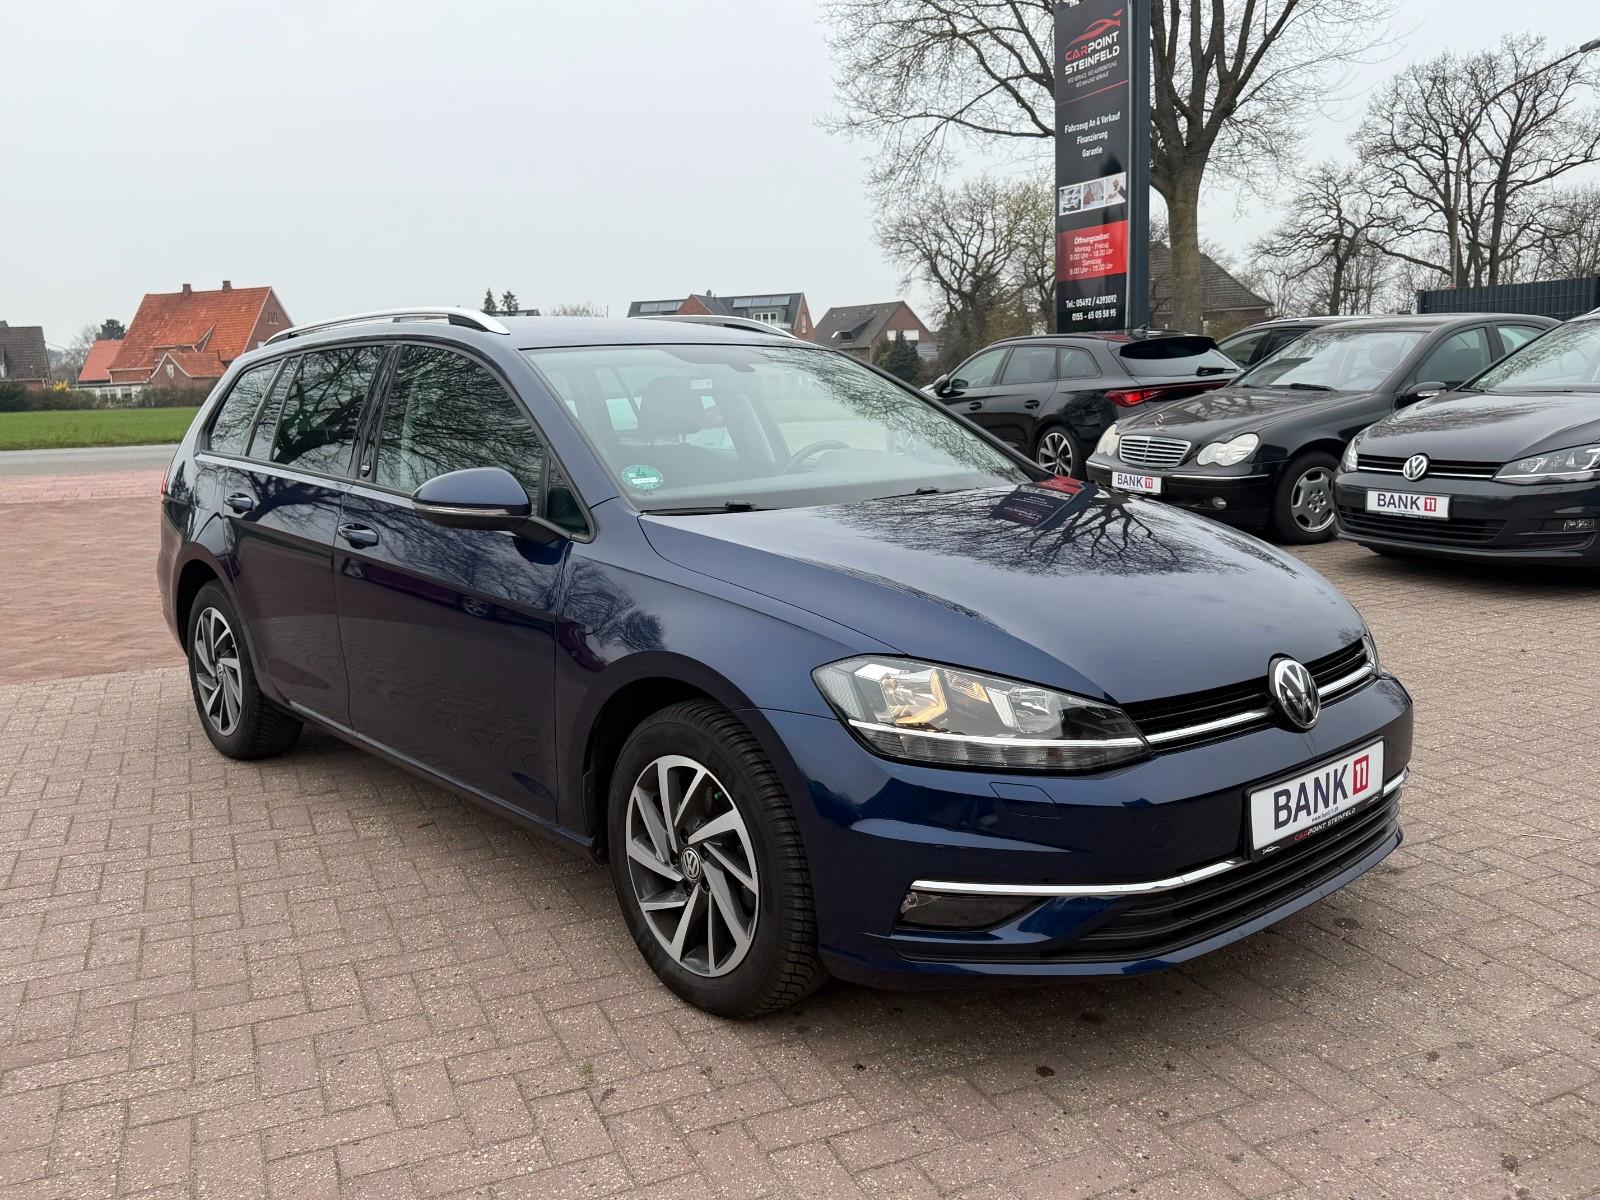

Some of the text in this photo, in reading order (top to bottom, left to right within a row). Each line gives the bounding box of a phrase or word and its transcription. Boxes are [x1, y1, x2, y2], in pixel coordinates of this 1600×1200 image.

[1065, 30, 1120, 61] CARPOINT
[1065, 45, 1120, 75] STEINFELD
[1064, 120, 1088, 134] Fahrzeug
[1089, 118, 1096, 127] An
[1101, 111, 1120, 124] Verkauf
[1076, 131, 1108, 144] Finanzierung
[1081, 145, 1103, 158] Garantie
[1076, 297, 1092, 307] 05492
[1096, 294, 1117, 305] 4393092
[1071, 312, 1084, 321] 0155
[1087, 310, 1095, 320] 65
[1095, 310, 1102, 319] 05
[1102, 309, 1110, 318] 58
[1110, 308, 1117, 317] 95
[1117, 474, 1143, 488] BANK
[1377, 493, 1421, 511] BANK
[1273, 758, 1368, 831] BANK 11
[1294, 807, 1356, 841] CARPOINT STEINFELD
